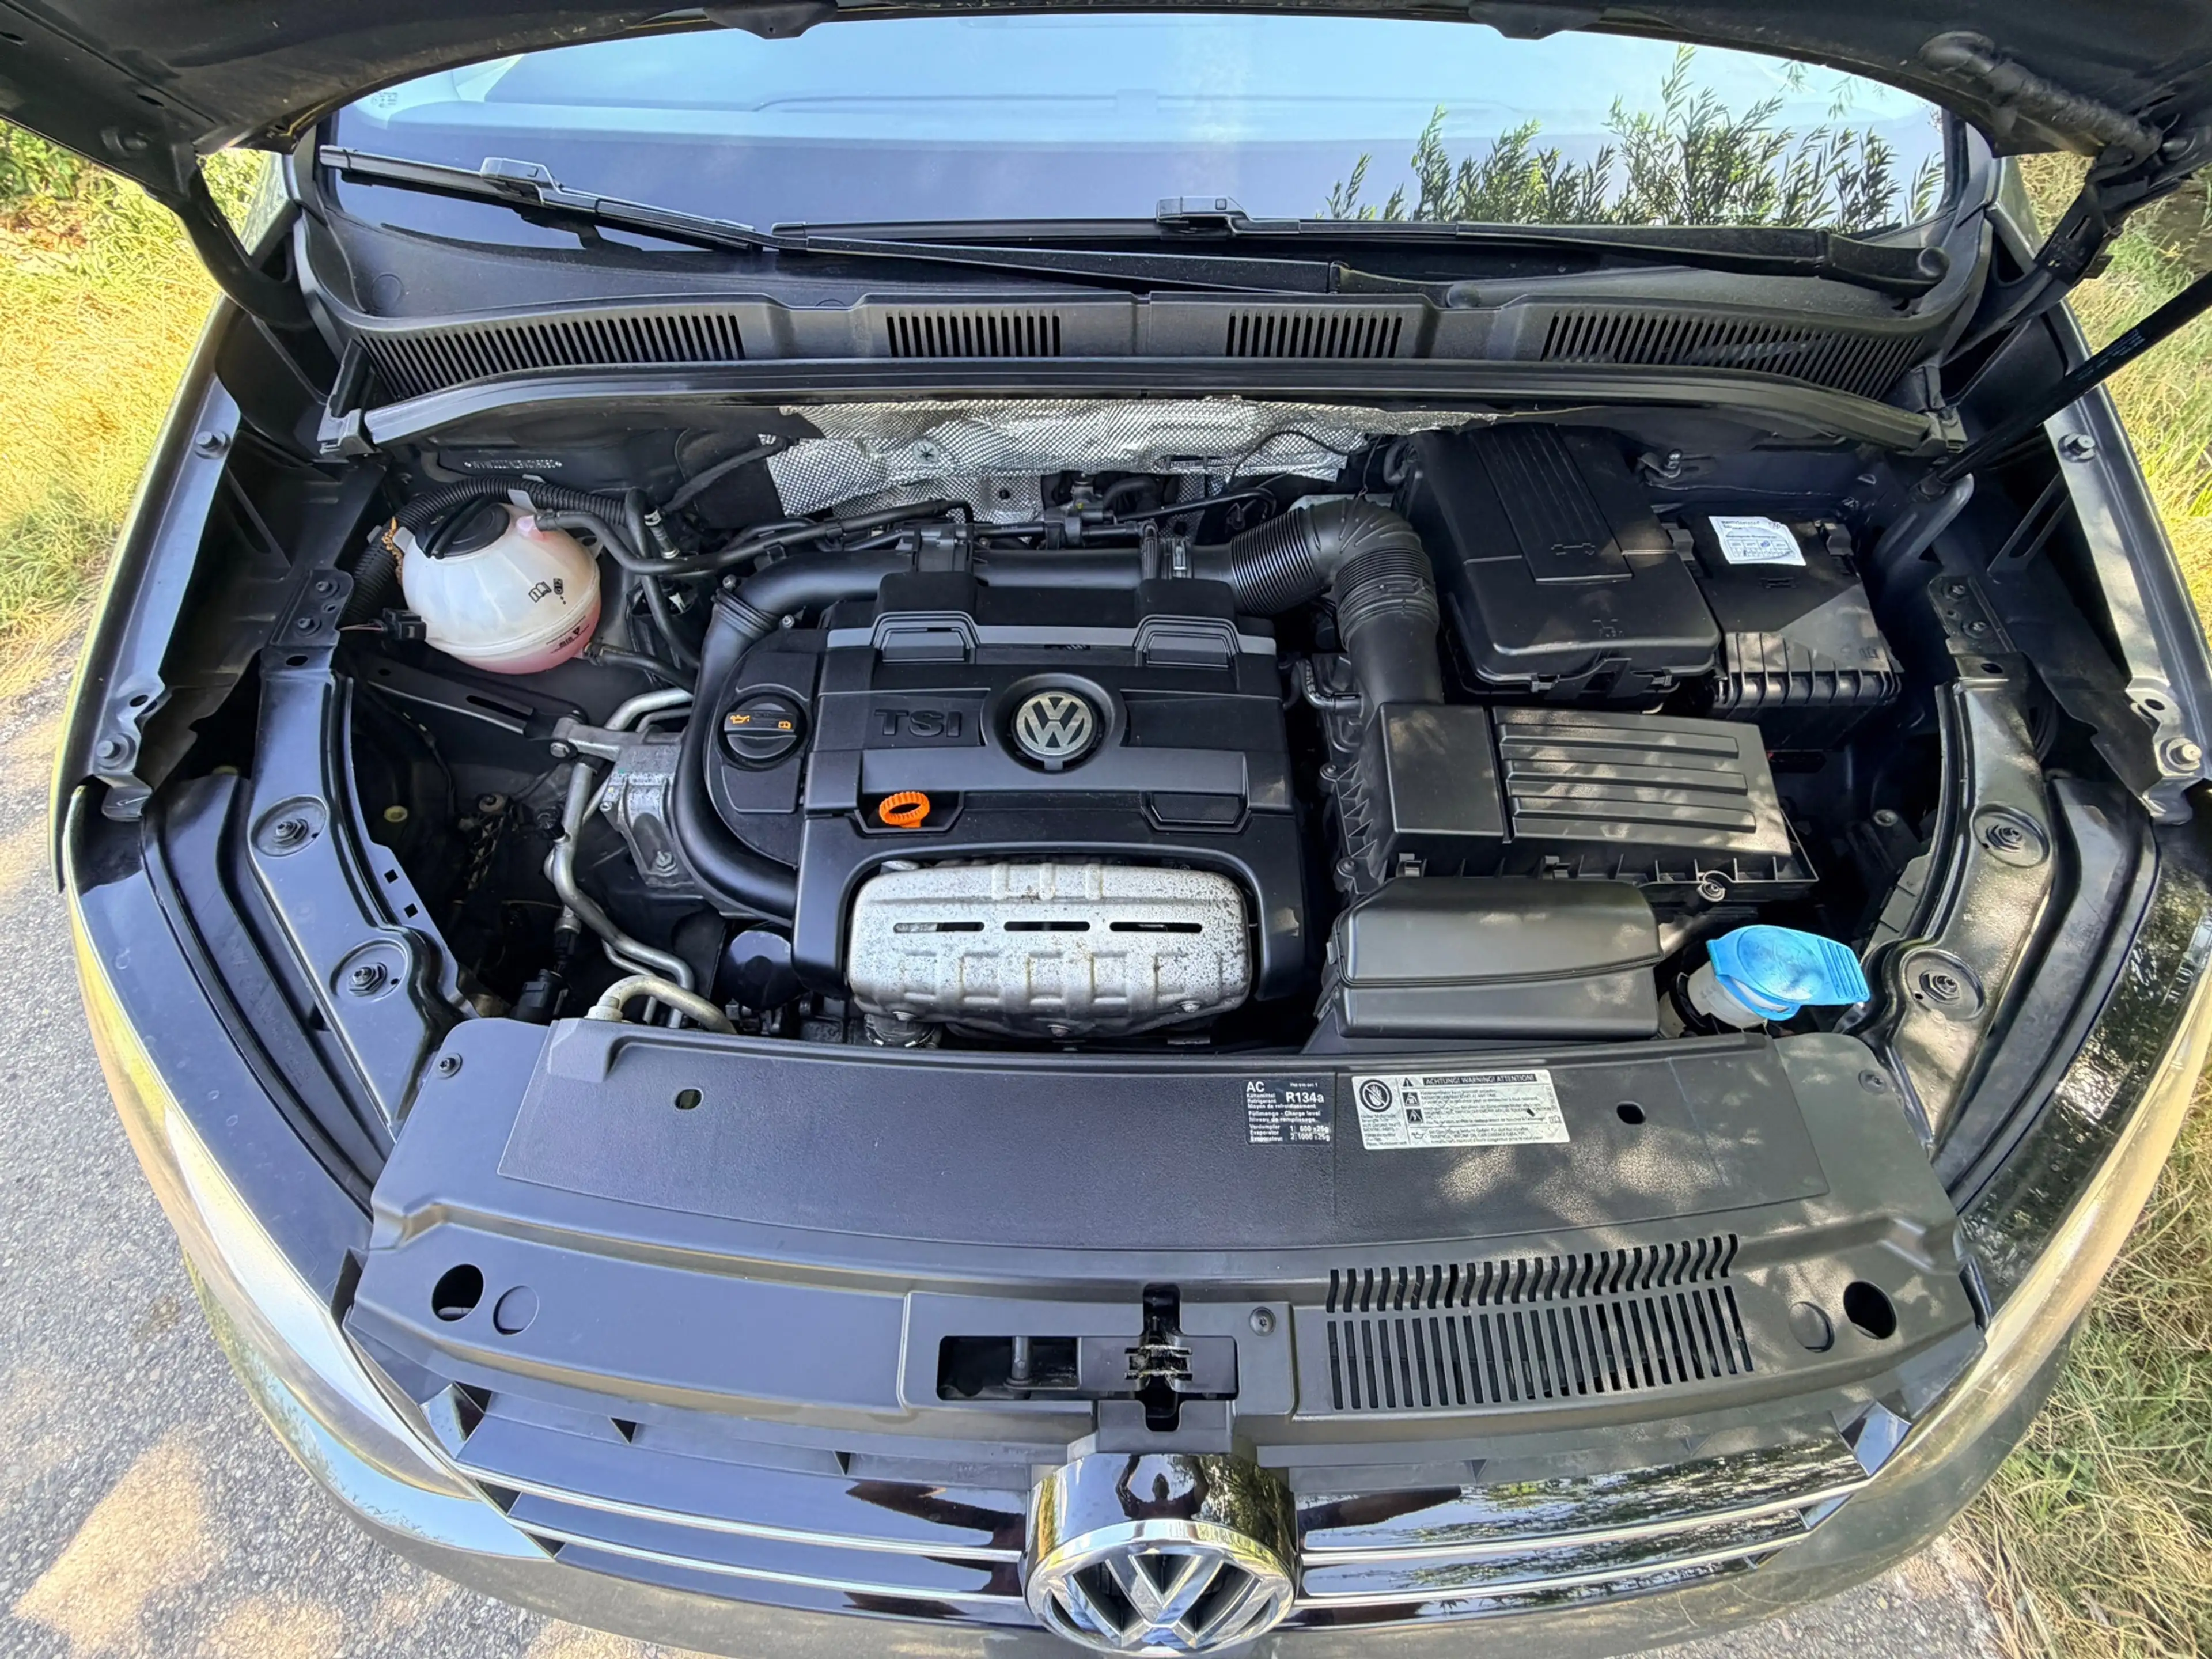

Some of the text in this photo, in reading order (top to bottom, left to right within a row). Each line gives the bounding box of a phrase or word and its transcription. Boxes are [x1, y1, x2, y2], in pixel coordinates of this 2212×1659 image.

[875, 709, 962, 737] TSI
[1247, 1081, 1265, 1092] AC
[1286, 1092, 1324, 1103] R134a
